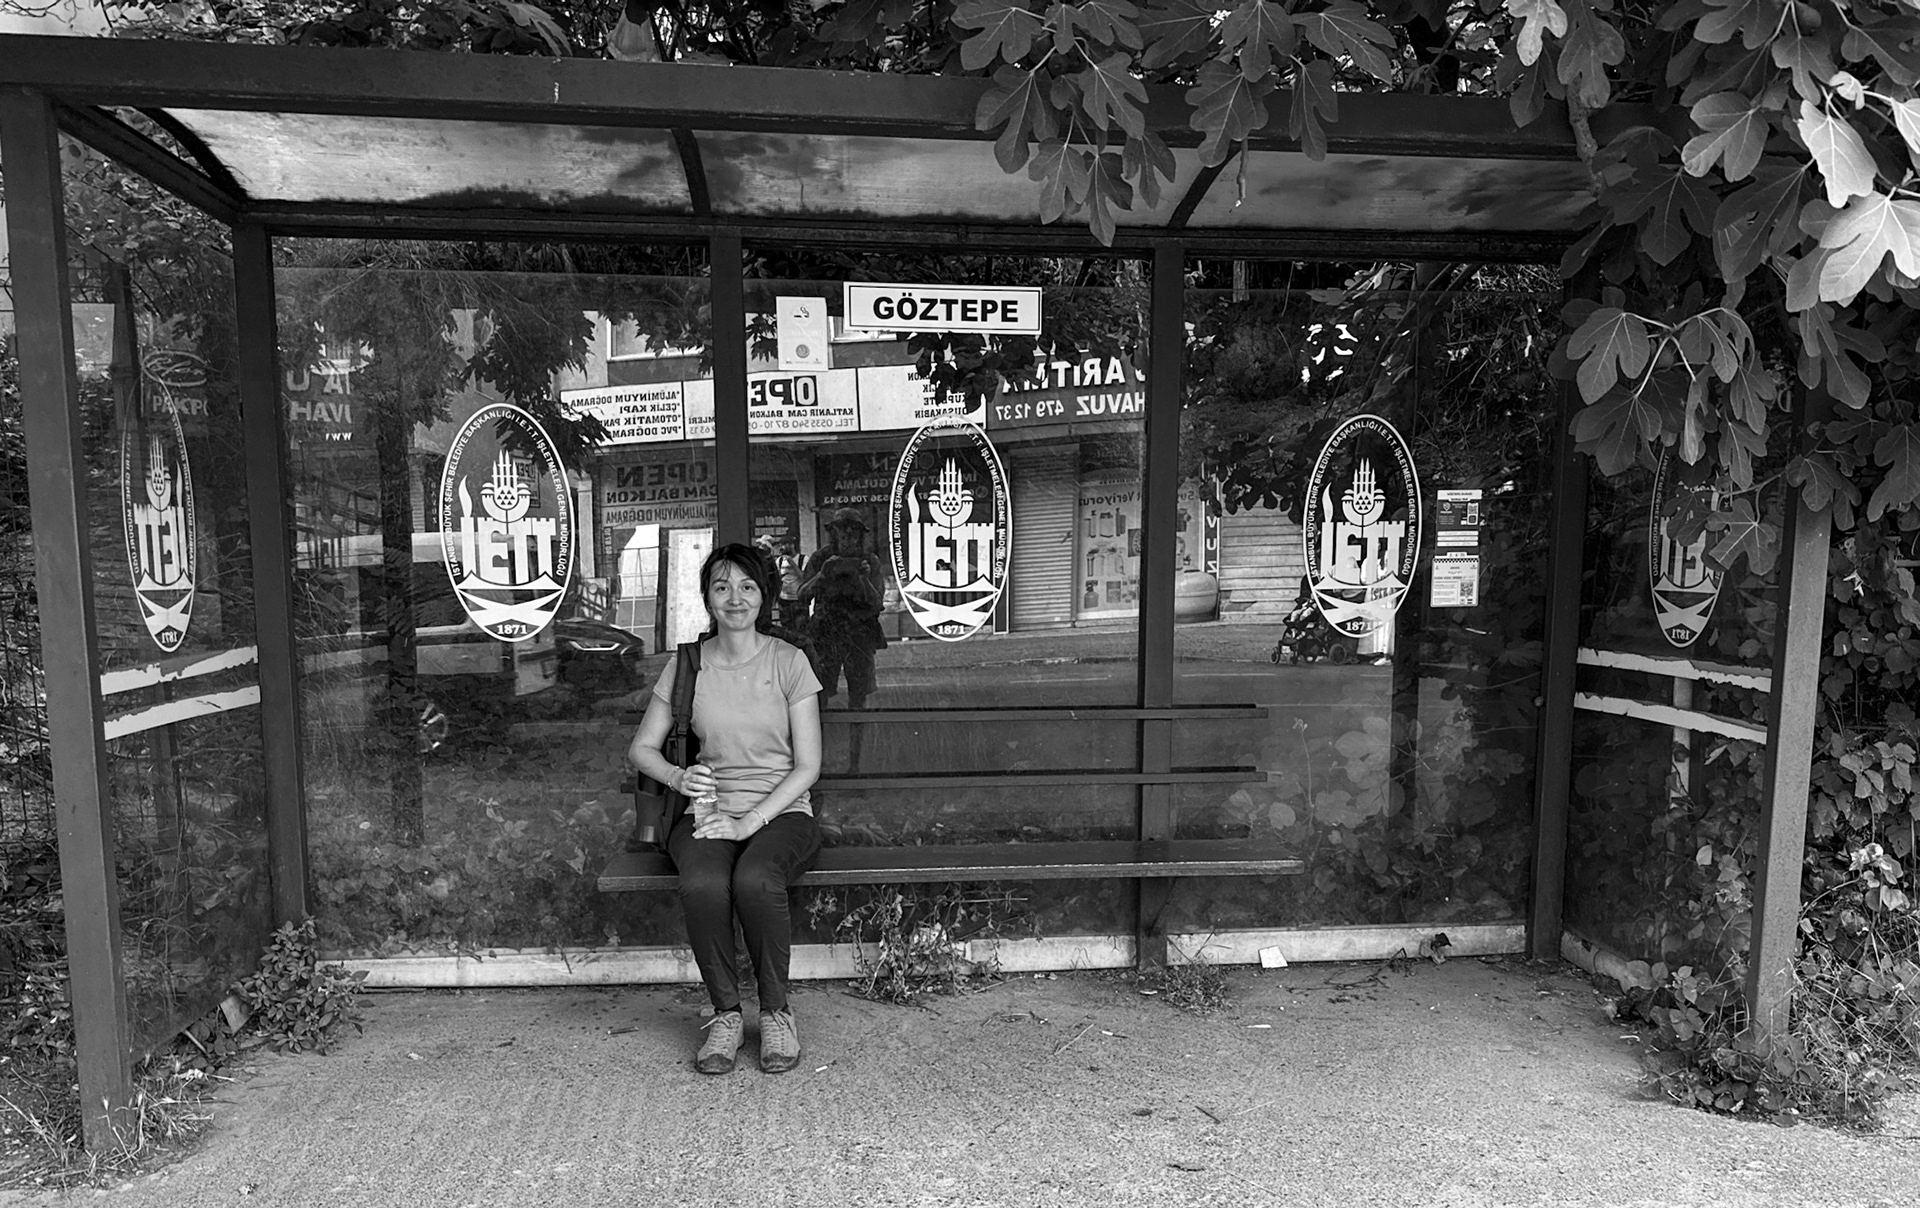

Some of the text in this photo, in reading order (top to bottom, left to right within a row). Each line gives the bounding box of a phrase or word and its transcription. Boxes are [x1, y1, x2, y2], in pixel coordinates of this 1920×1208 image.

[873, 292, 1018, 322] GÖZTEPE
[556, 494, 568, 522] GENEL
[997, 501, 1007, 528] GENEL
[1408, 498, 1416, 524] GENEL
[497, 624, 528, 635] 1871
[937, 624, 965, 635] 1871
[1345, 621, 1372, 631] 1871
